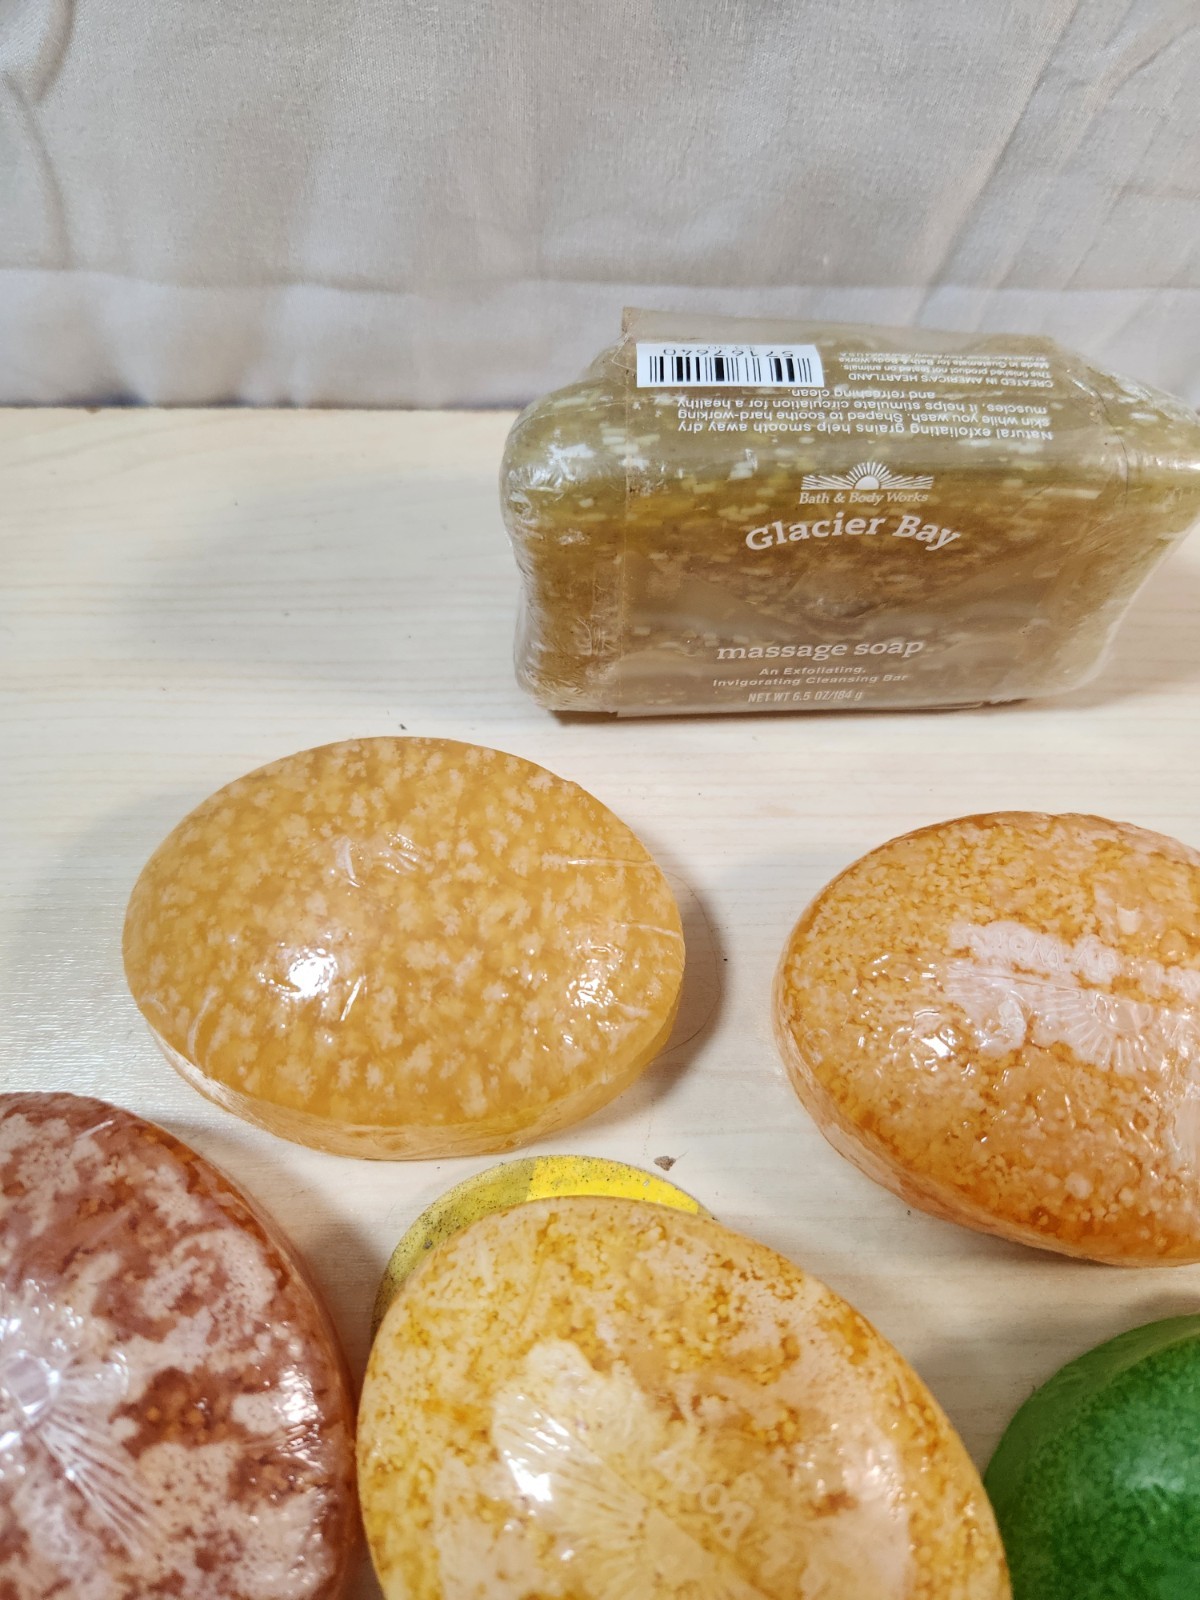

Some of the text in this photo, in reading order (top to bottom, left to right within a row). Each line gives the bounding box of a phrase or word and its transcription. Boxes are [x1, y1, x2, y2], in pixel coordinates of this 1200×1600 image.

[663, 349, 794, 357] 57167640
[849, 373, 918, 382] HEARTLAND
[922, 374, 982, 384] AMERICA'S
[1001, 378, 1053, 387] CREATED
[788, 388, 936, 399] and refreshing clean.
[678, 399, 731, 409] healthy
[749, 399, 768, 408] for
[773, 399, 849, 408] circulation
[854, 400, 920, 410] stimulate
[926, 401, 965, 412] helps
[678, 408, 1051, 427] skin while you wash. Shaped to soothe hard-working
[678, 420, 1053, 441] Natural exfoliating grains help smooth away dry
[799, 492, 929, 505] Bath & Body Works
[745, 512, 962, 550] Glacier Bay
[717, 640, 924, 660] massage soap
[713, 674, 909, 687] Invigorating Cleansing Bar
[748, 693, 771, 703] NET
[774, 692, 790, 702] WT
[793, 692, 810, 701] 6.5
